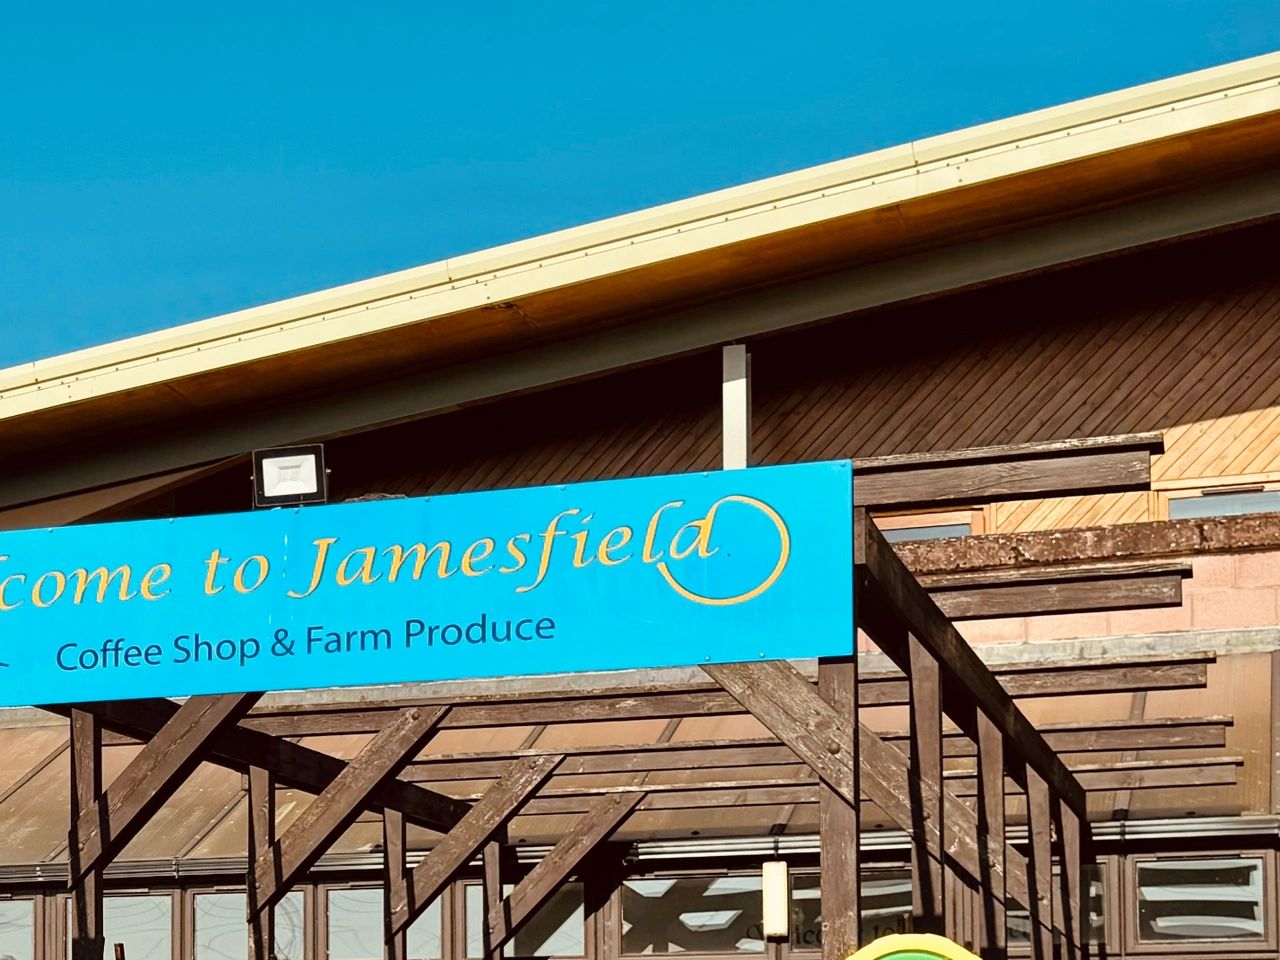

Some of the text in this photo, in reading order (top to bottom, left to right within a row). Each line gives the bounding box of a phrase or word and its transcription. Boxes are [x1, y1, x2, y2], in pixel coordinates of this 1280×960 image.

[204, 548, 269, 596] to
[287, 495, 790, 605] Jamesfield
[56, 613, 556, 671] Coffee Shop & Farm Produce
